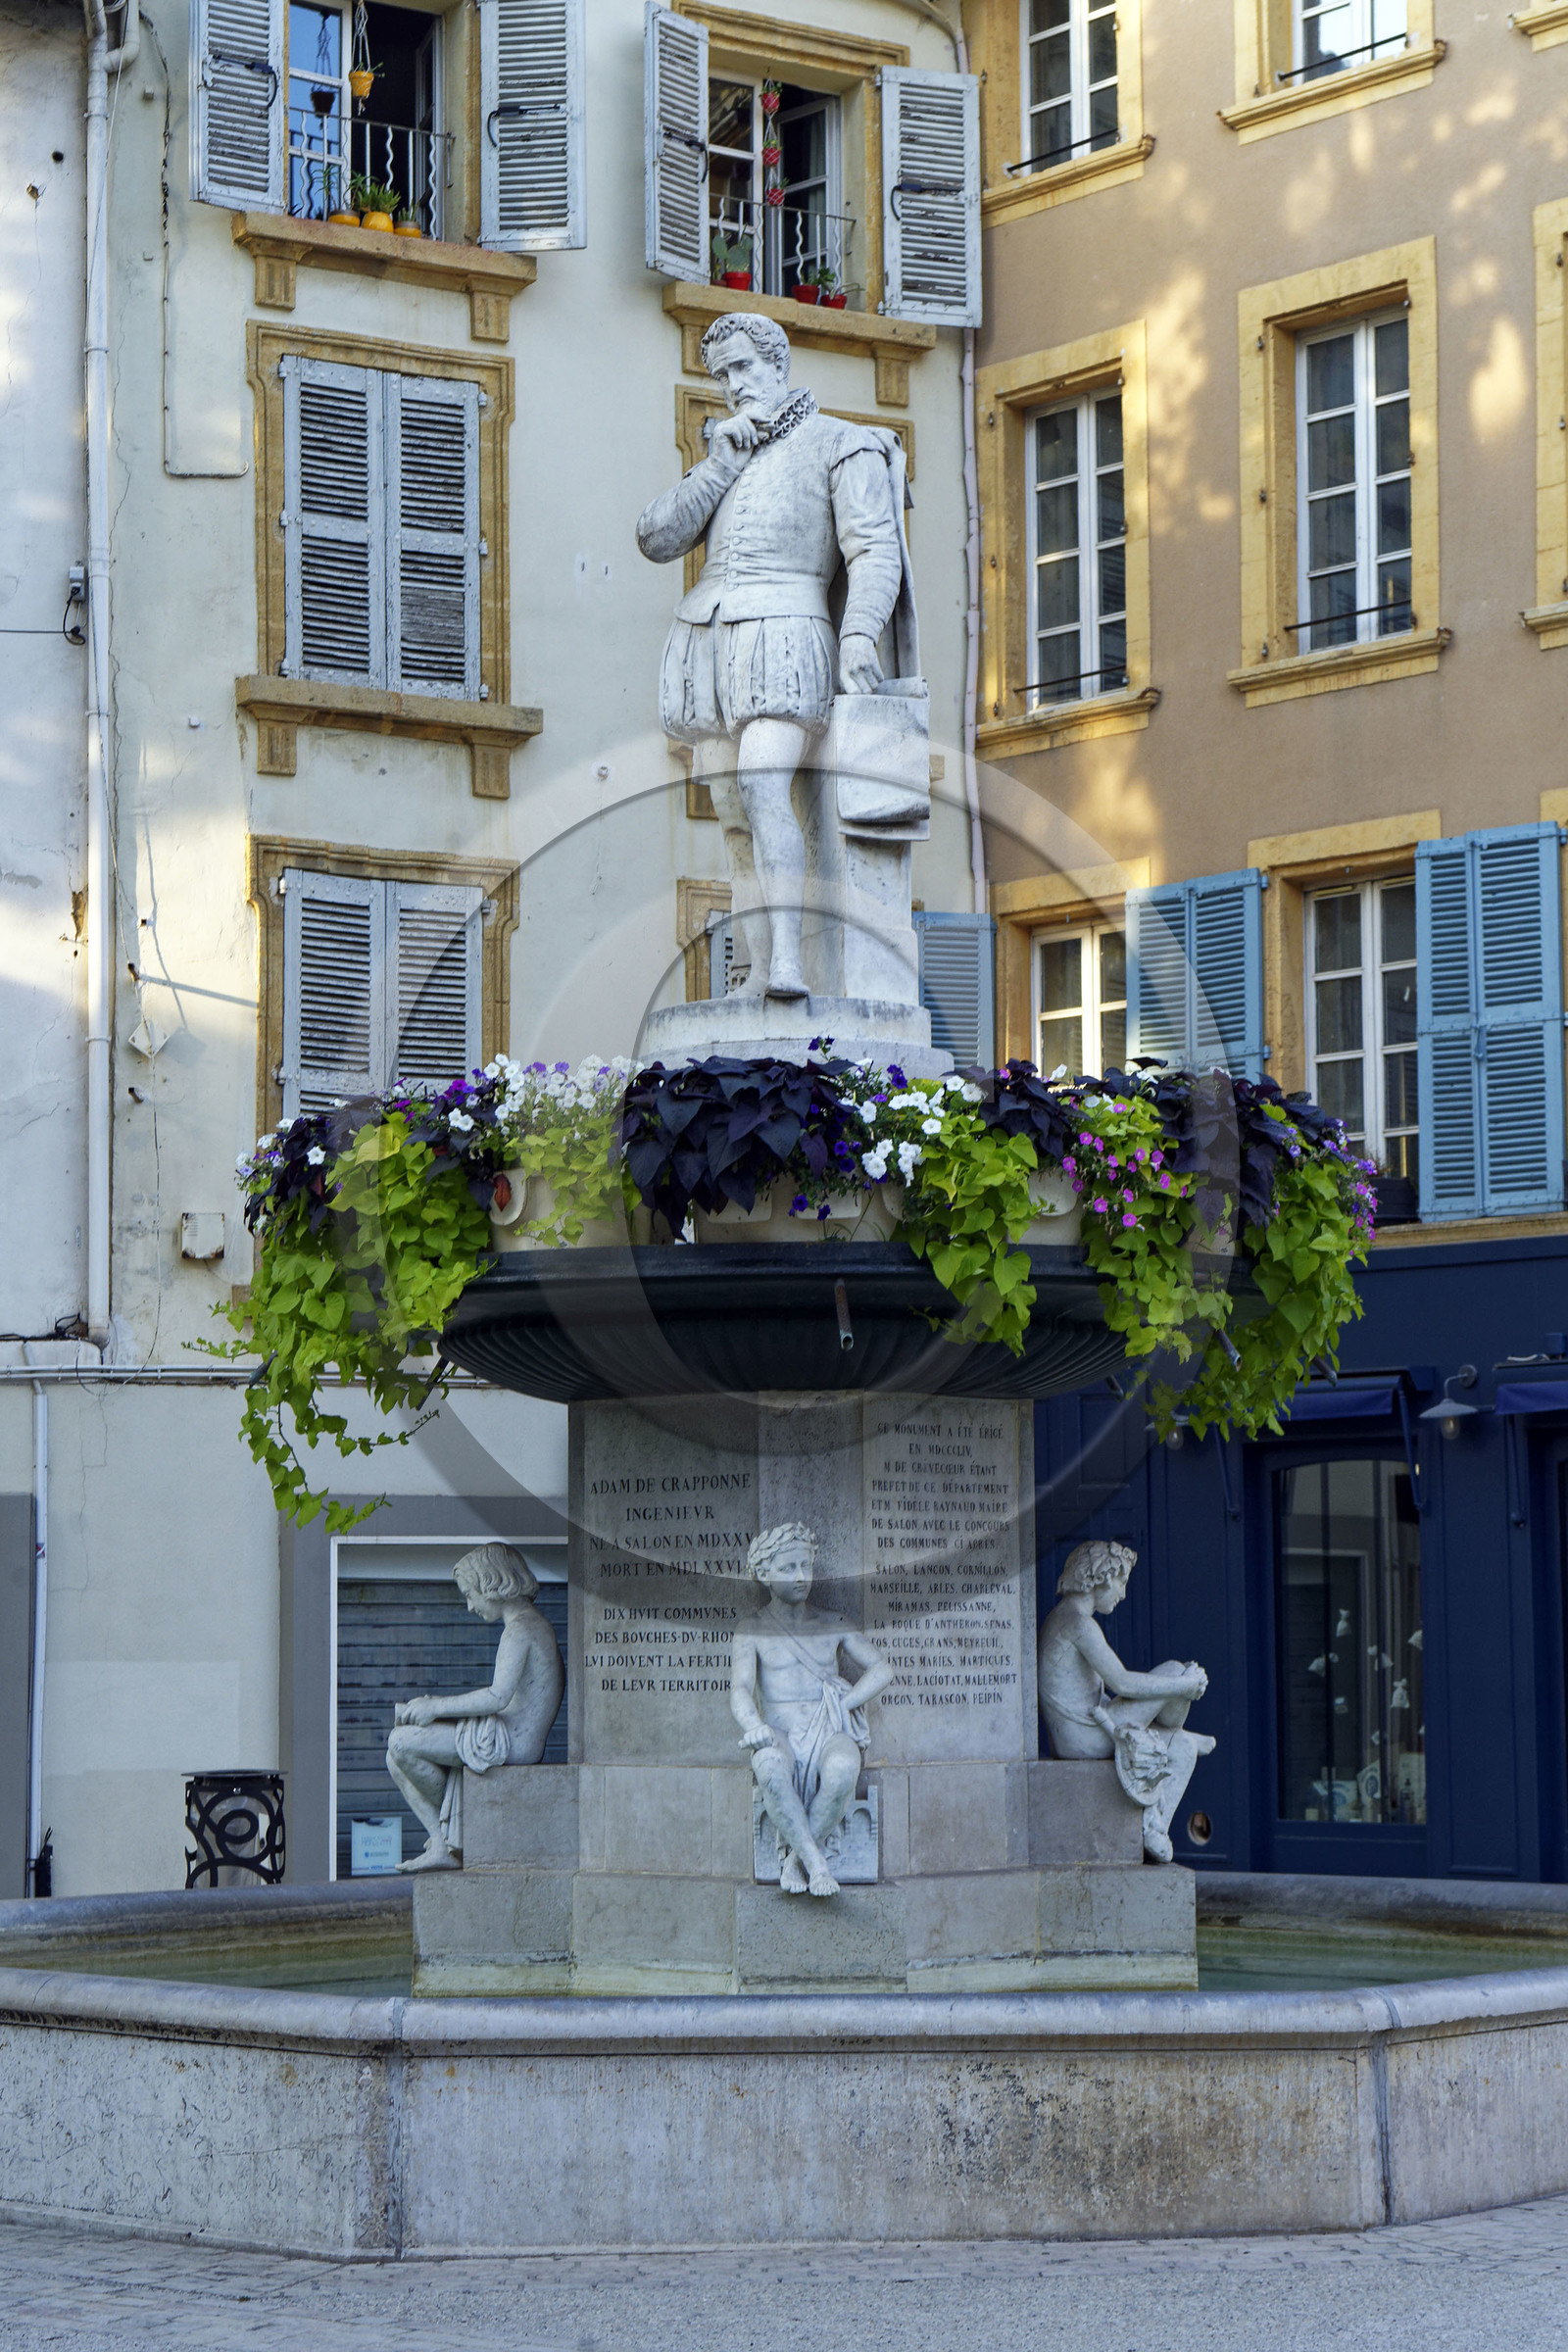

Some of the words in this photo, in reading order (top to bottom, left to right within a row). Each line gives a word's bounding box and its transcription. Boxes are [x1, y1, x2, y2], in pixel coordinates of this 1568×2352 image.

[894, 1423, 941, 1437] MONUMENT
[909, 1444, 920, 1454] EN
[895, 1460, 906, 1473] DE
[590, 1478, 630, 1494] ADAM
[636, 1477, 656, 1493] DE
[662, 1473, 752, 1492] CRAPPONNE
[909, 1481, 920, 1492] DE
[924, 1481, 936, 1493] CE
[626, 1506, 714, 1521] INGENIEVR
[872, 1519, 883, 1529] DE
[888, 1519, 917, 1530] SALON
[922, 1520, 947, 1531] AVEC
[950, 1520, 960, 1531] LE
[965, 1520, 1010, 1532] CONCOURS
[625, 1536, 671, 1549] SALON
[675, 1535, 693, 1548] EN
[878, 1537, 894, 1548] DES
[900, 1538, 948, 1548] COMMUNES
[600, 1562, 642, 1578] MORT
[646, 1562, 664, 1576] EN
[604, 1607, 625, 1620] DIX
[629, 1607, 660, 1620] HVIT
[664, 1606, 737, 1619] COMMVNES
[874, 1619, 885, 1630] LA
[893, 1619, 920, 1632] ROQUE
[595, 1632, 618, 1644] DES
[585, 1655, 604, 1667] LVI
[608, 1655, 663, 1667] DOIVENT
[668, 1655, 684, 1667] LA
[602, 1679, 617, 1691] DE
[622, 1679, 656, 1691] LEVR
